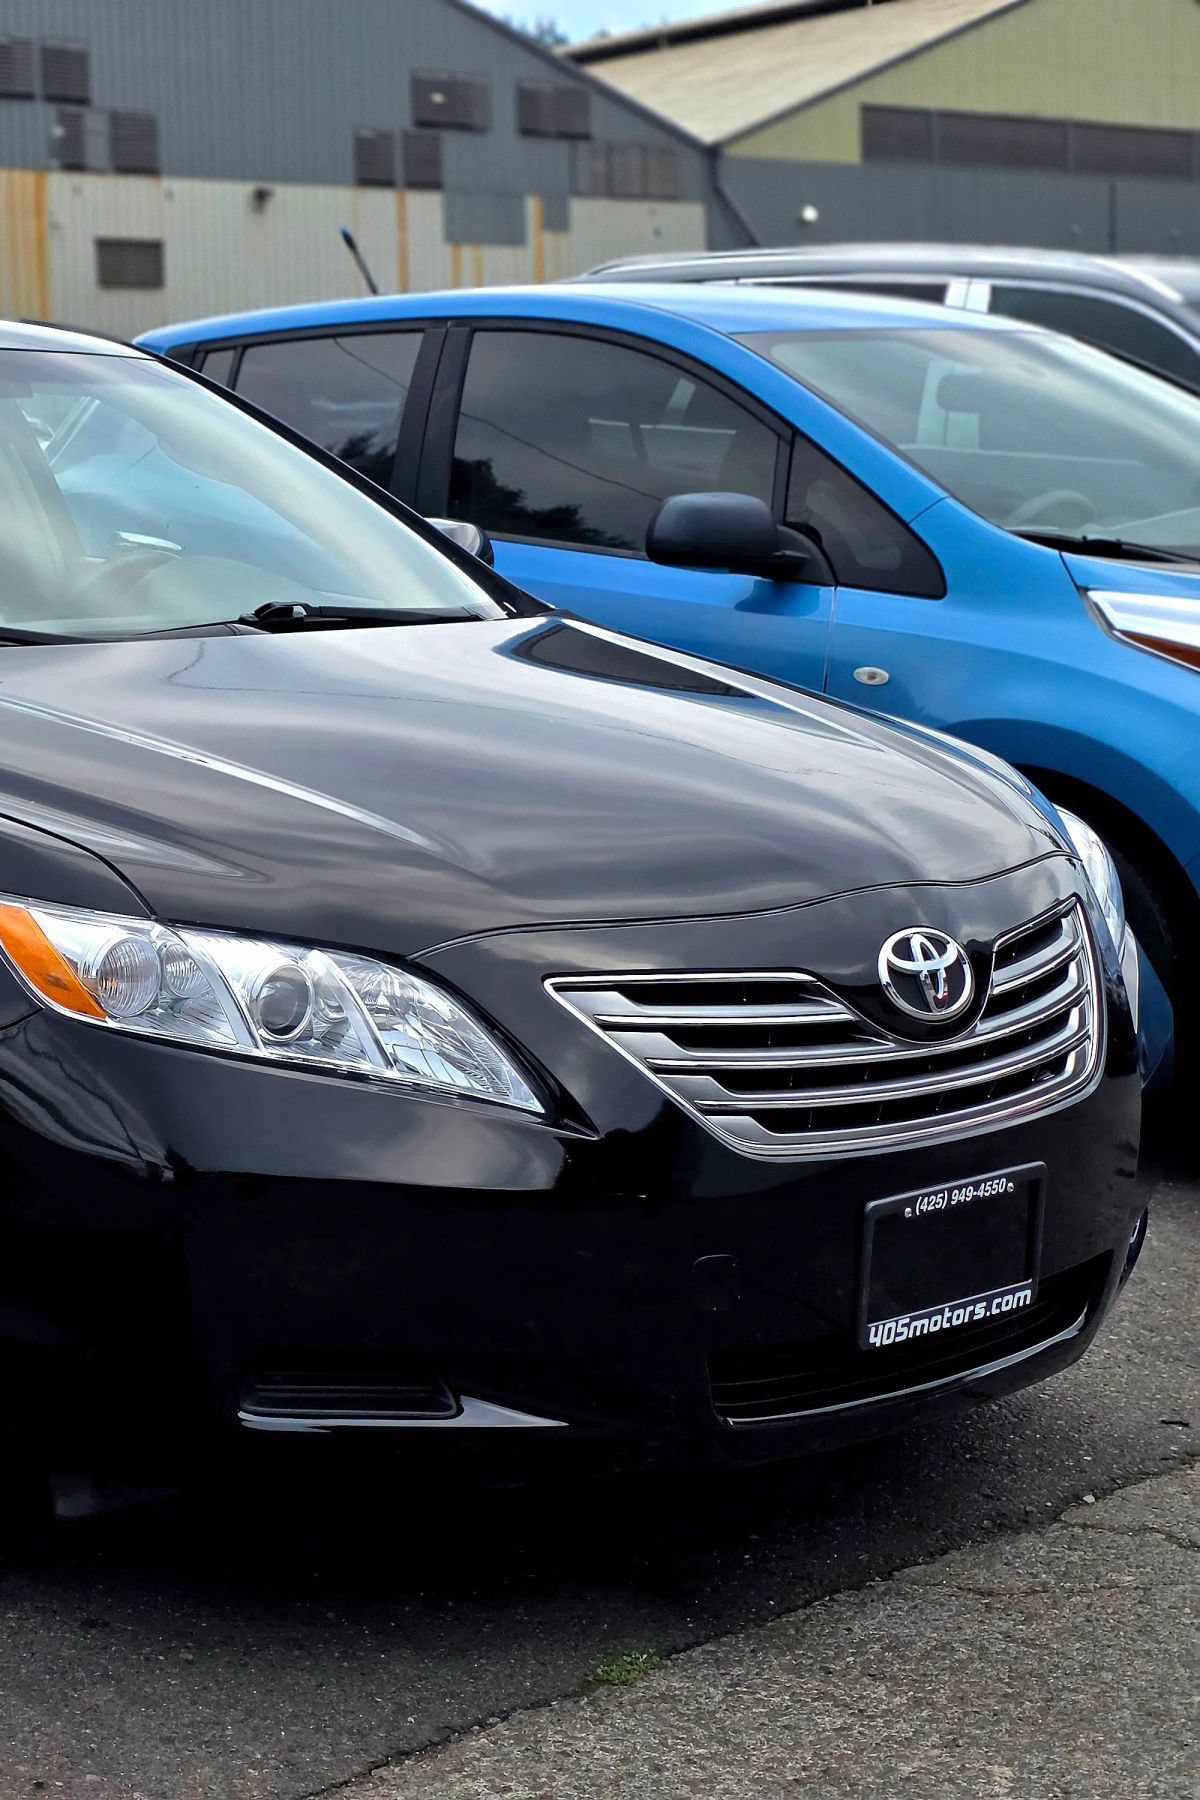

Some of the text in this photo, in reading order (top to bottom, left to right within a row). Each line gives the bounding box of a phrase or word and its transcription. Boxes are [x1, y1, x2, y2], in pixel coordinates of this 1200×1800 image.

[915, 1178, 1007, 1215] (425) 949-4550
[869, 1289, 1032, 1347] 405motors.com
